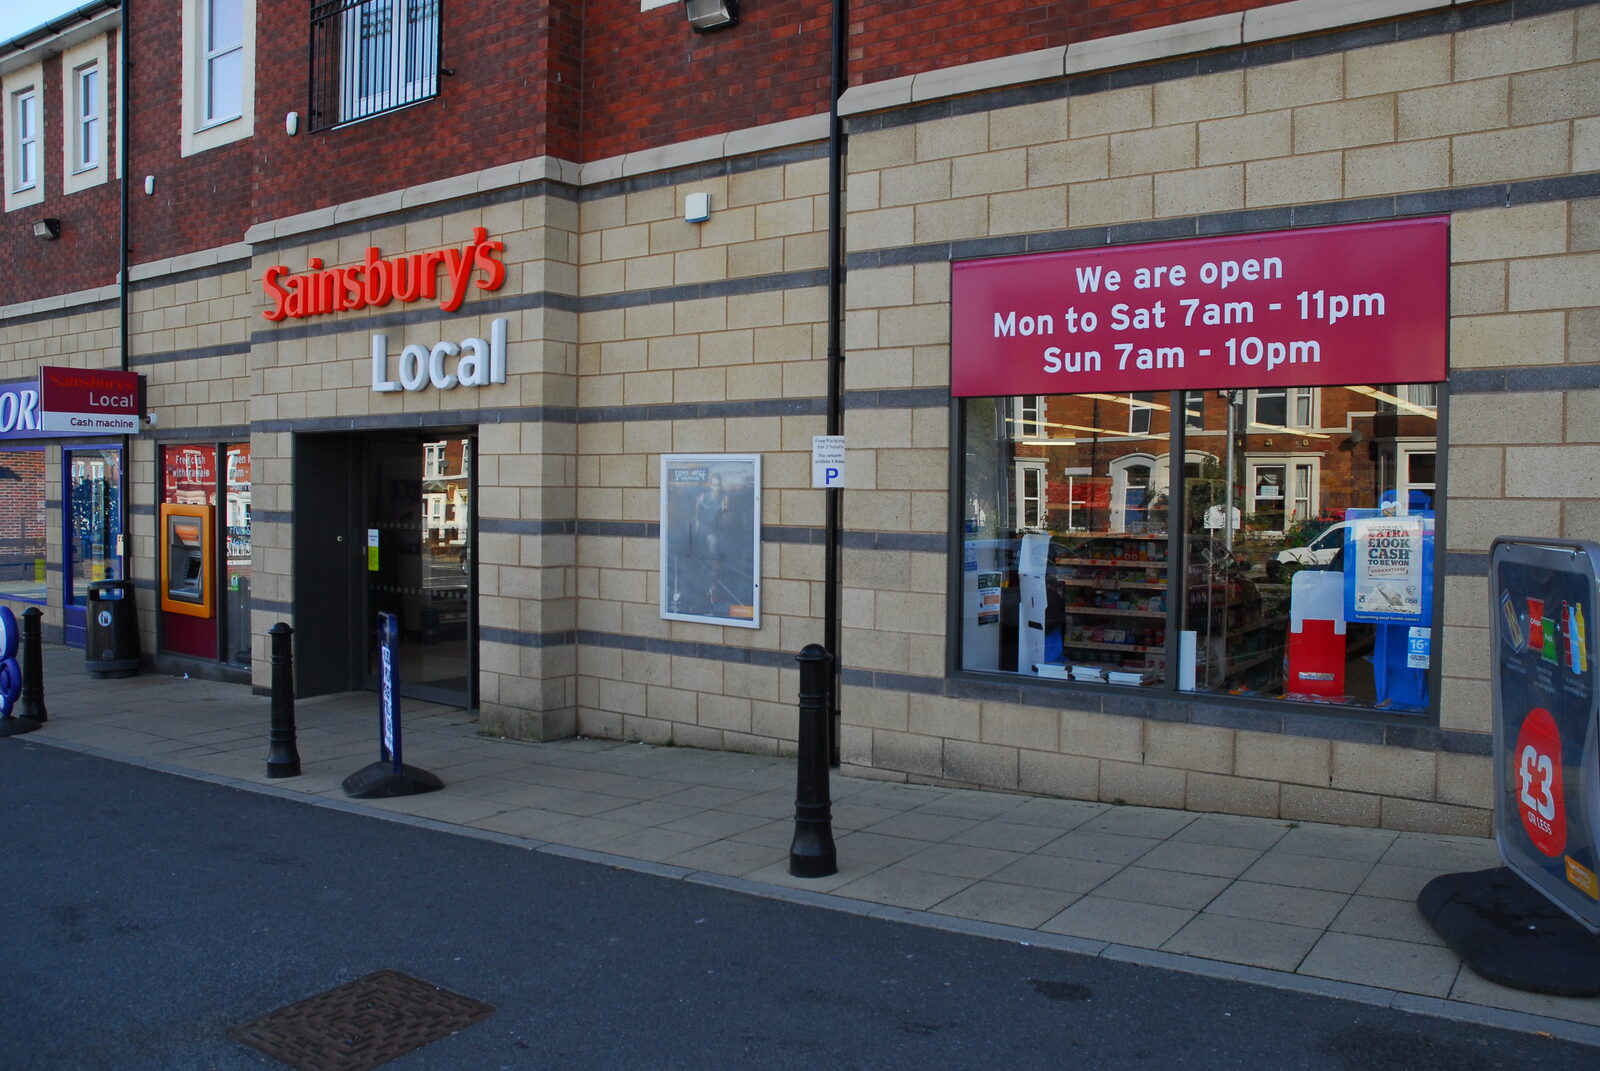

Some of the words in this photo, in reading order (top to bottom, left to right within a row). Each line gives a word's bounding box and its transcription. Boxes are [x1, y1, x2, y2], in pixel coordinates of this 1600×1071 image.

[262, 227, 506, 322] Sainsbury's
[1075, 265, 1121, 294] We
[1133, 262, 1187, 290] are
[1199, 256, 1284, 290] open
[993, 310, 1054, 338] Mon
[1065, 306, 1098, 335] to
[1110, 300, 1166, 331] Sat
[1178, 297, 1254, 328] 7am
[1296, 289, 1386, 326] 11pm
[372, 317, 508, 392] Local
[1043, 344, 1102, 375] Sun
[1113, 342, 1185, 371] 7am
[1223, 335, 1322, 372] 10pm
[0, 389, 41, 433] OR
[89, 391, 134, 408] Local
[70, 417, 94, 427] Cash
[95, 418, 134, 428] machine
[825, 467, 839, 485] P
[1368, 538, 1410, 549] £100K
[1368, 549, 1410, 560] CASH
[1519, 744, 1555, 821] £3
[1527, 811, 1538, 826] OR
[1536, 817, 1553, 835] LESS
